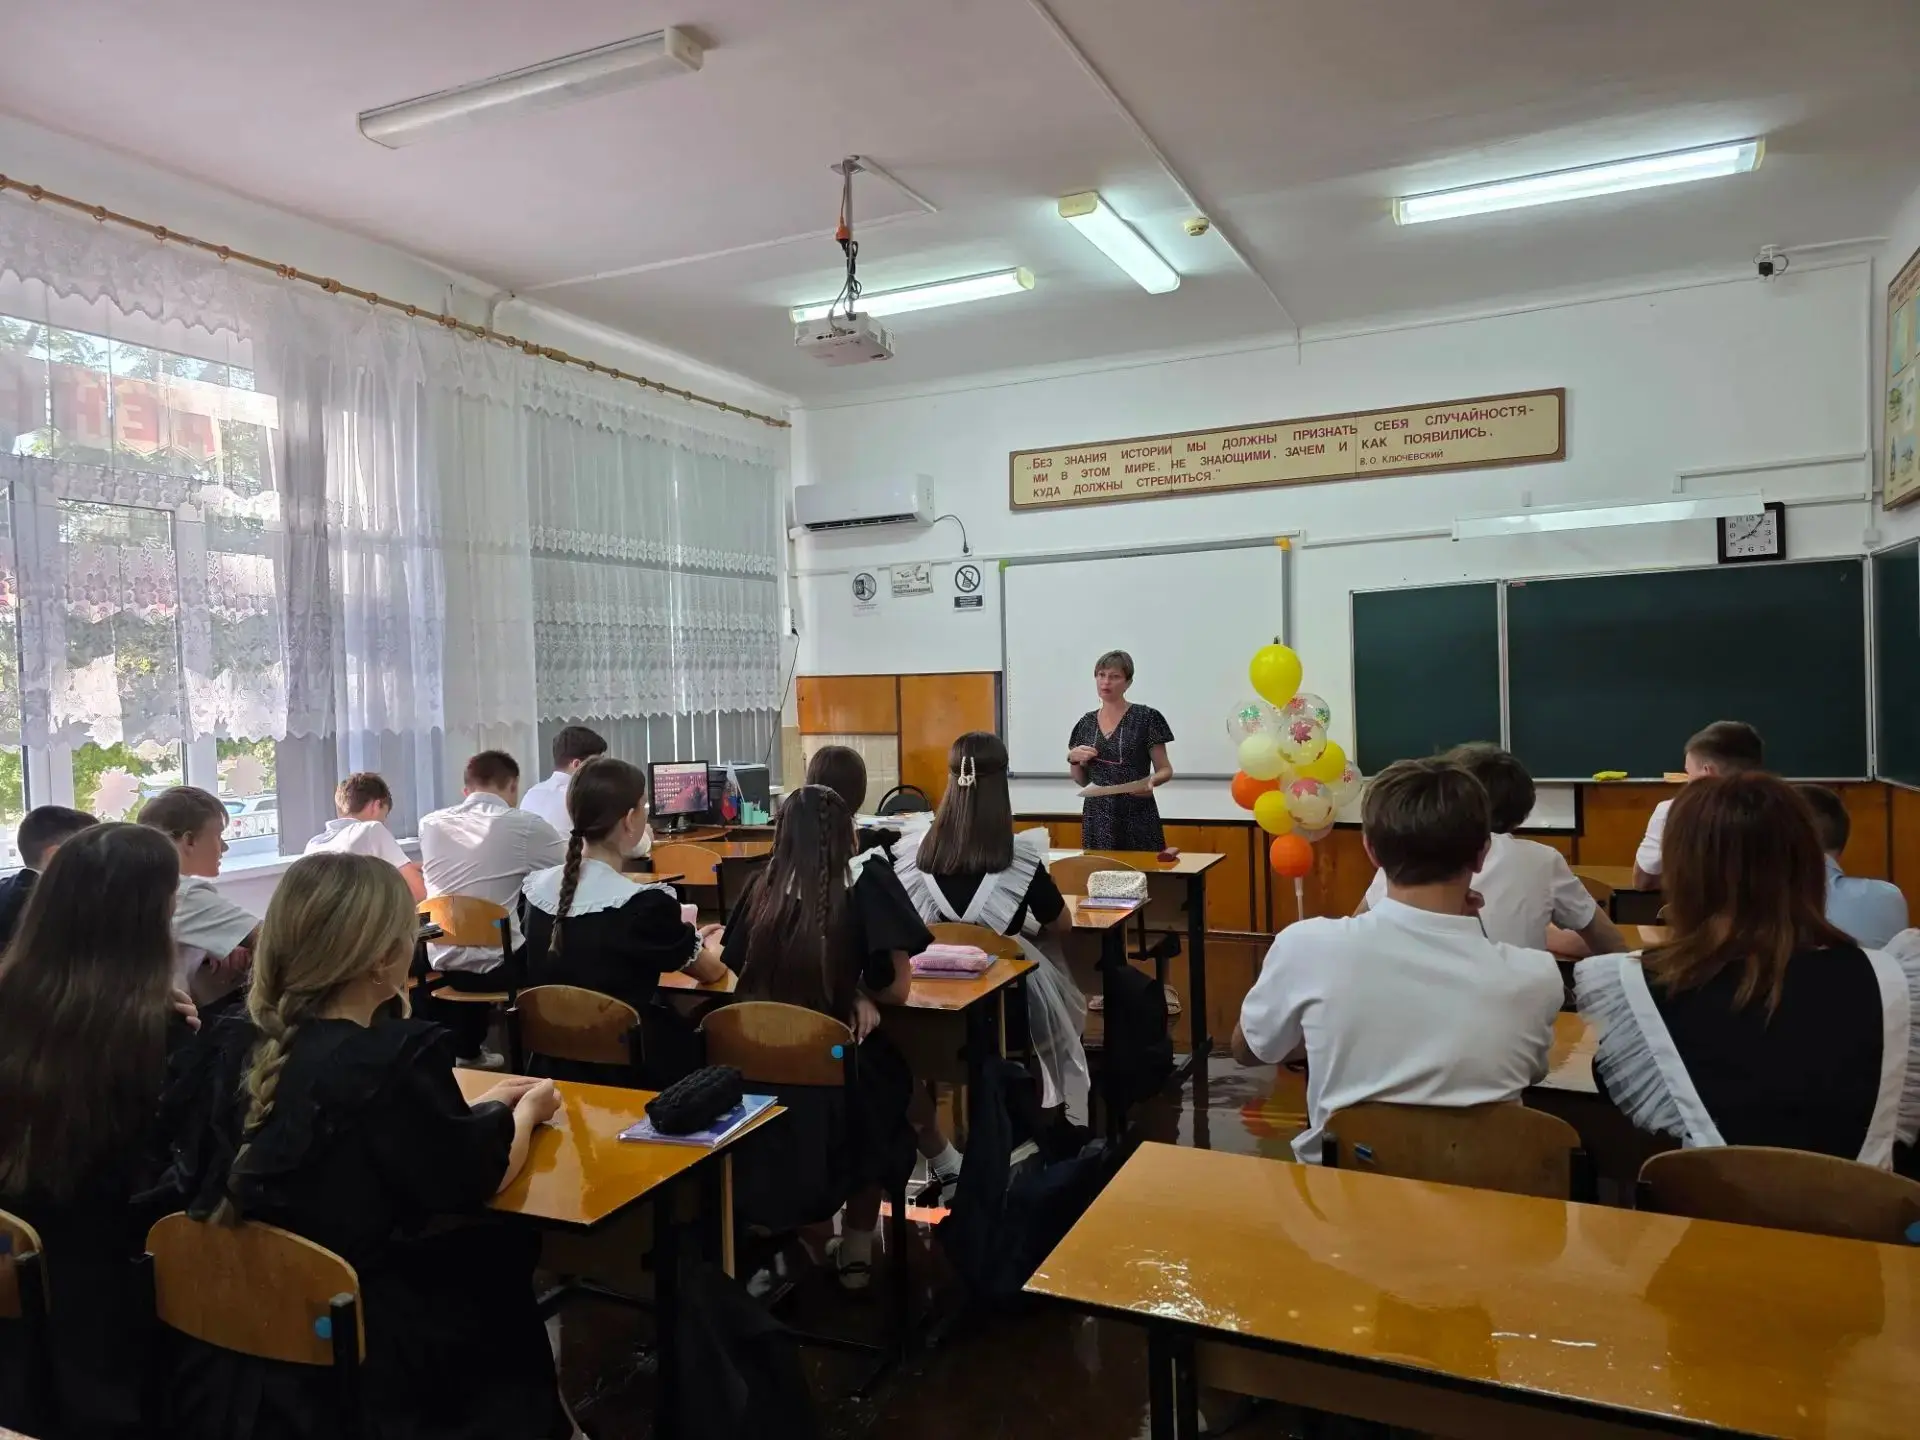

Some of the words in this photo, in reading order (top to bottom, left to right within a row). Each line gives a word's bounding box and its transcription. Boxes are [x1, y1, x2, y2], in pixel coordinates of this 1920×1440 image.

[1064, 452, 1107, 466] ЗНАНИЯ
[1121, 445, 1172, 460] ИСТОРИИ
[1187, 441, 1206, 453] МЫ
[1222, 433, 1277, 451] ДОЛЖНЫ
[1293, 424, 1358, 441] ПРИЗНАТЬ
[1374, 418, 1409, 432] СЕБЯ
[1382, 449, 1444, 464] КЛЮЧЕВСКИЙ
[1033, 473, 1048, 483] МИ
[1061, 471, 1068, 481] В
[1081, 466, 1110, 478] ЭТОМ
[1171, 458, 1186, 469] НЕ
[1285, 443, 1325, 457] ЗАЧЕМ
[1339, 441, 1347, 452] И
[1361, 437, 1388, 450] КАК
[1033, 486, 1061, 498] КУДА
[1073, 479, 1123, 496] ДОЛЖНЫ
